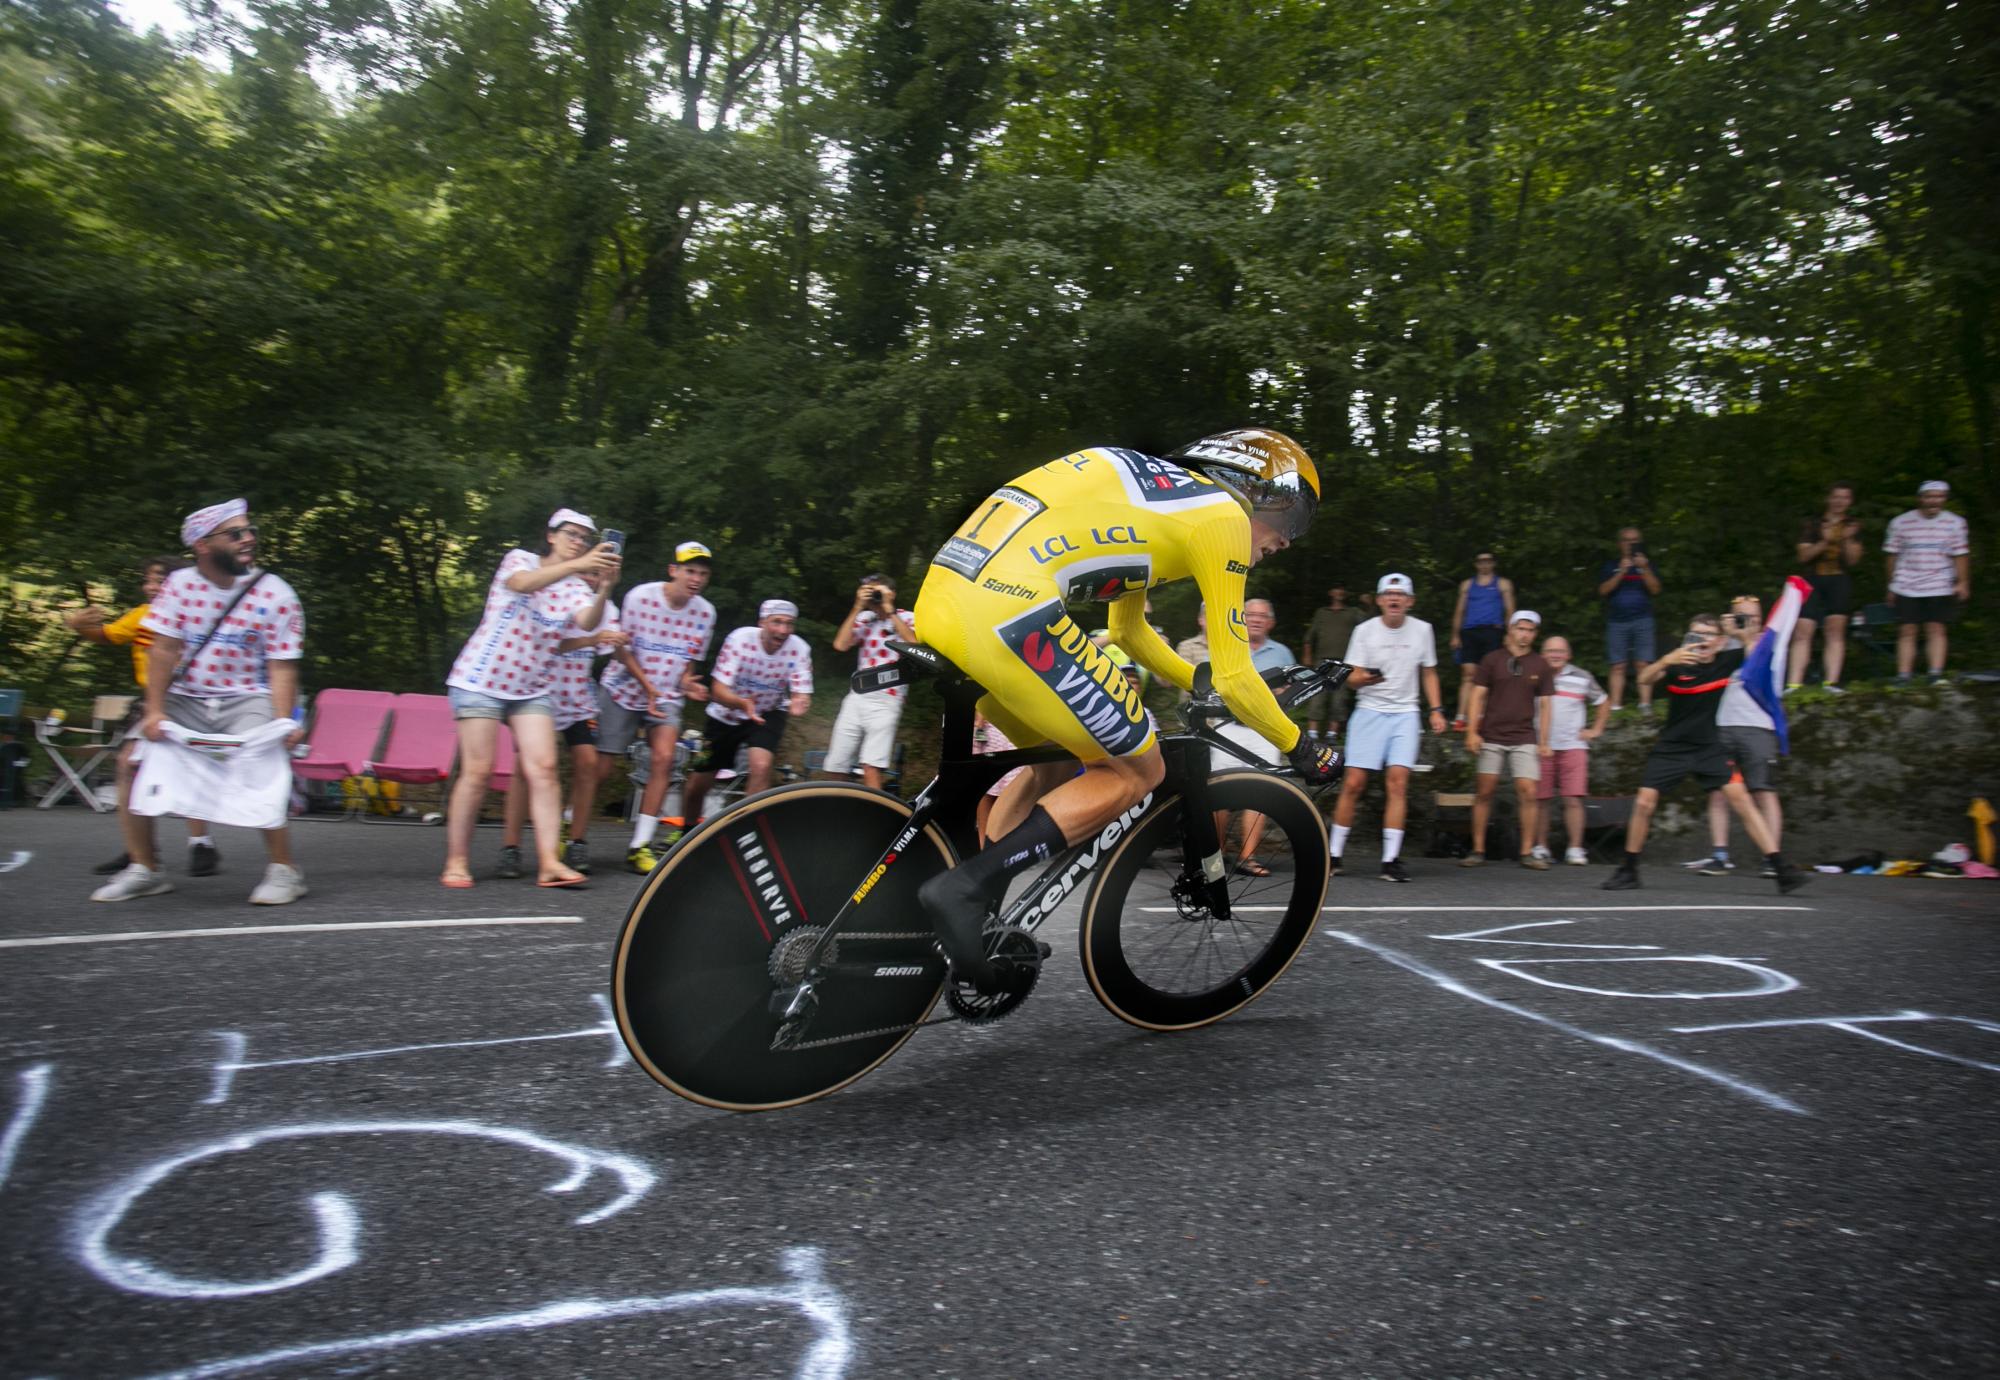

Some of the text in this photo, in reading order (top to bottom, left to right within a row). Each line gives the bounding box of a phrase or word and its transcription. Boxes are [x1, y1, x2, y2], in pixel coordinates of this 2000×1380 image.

[1183, 445, 1267, 473] LAZER
[966, 500, 1005, 540] 1
[1028, 534, 1080, 564] LCL
[1091, 526, 1147, 545] LCL
[982, 577, 1040, 600] Santini
[1232, 607, 1247, 626] LC
[1046, 613, 1144, 724] JUMBO
[1055, 664, 1132, 750] VISMA
[893, 826, 919, 853] VISMA
[851, 863, 887, 905] JUMBO
[873, 966, 924, 977] SRAM
